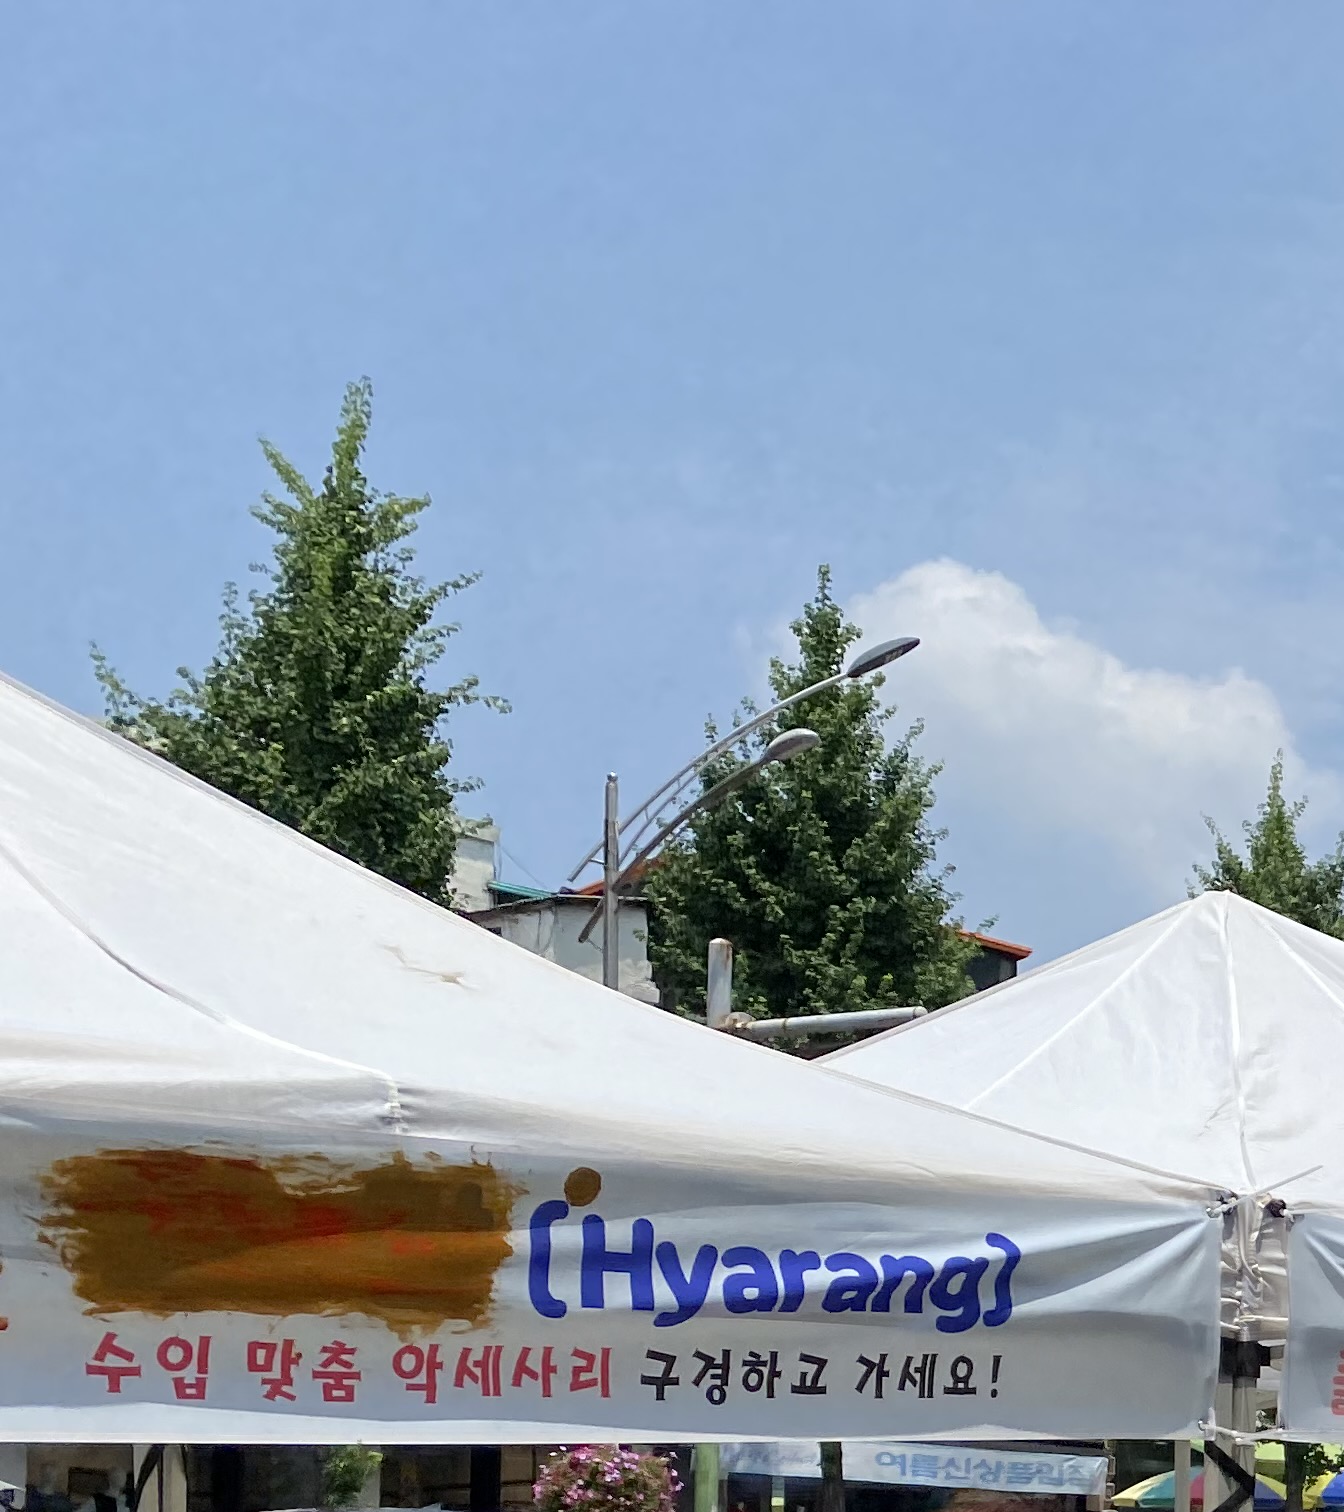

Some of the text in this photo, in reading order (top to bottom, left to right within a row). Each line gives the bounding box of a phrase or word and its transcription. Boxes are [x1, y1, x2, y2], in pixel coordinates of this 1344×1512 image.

[86, 1332, 1002, 1406] 수입 맞춤 악세사리 구경하고 가세요!
